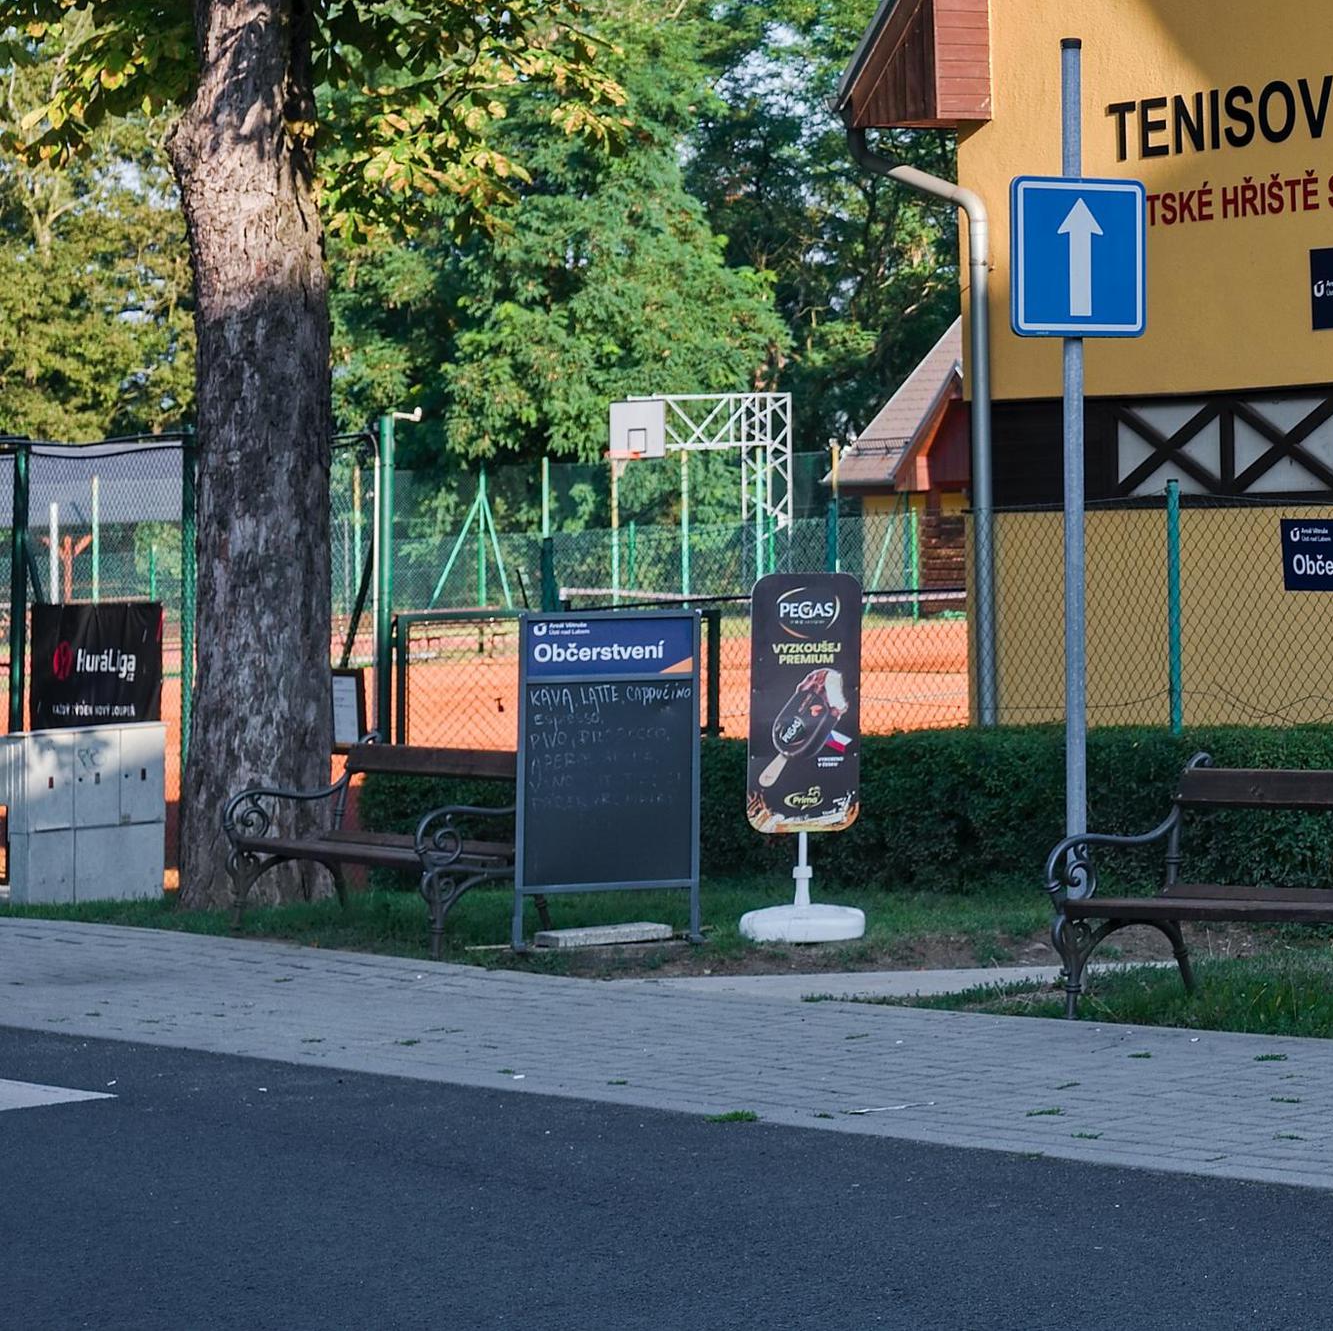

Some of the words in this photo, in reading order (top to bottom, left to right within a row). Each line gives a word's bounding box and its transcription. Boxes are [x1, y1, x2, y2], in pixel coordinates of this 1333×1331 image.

[1145, 180, 1214, 227] TSKÉ
[1222, 170, 1320, 219] HŘIŠTĚ
[780, 601, 834, 619] PEGAS
[533, 640, 665, 663] Občerstvení
[772, 640, 841, 654] VYZKOUŠEJ
[76, 648, 137, 679] HuráLiga
[778, 654, 834, 665] PREMIUM
